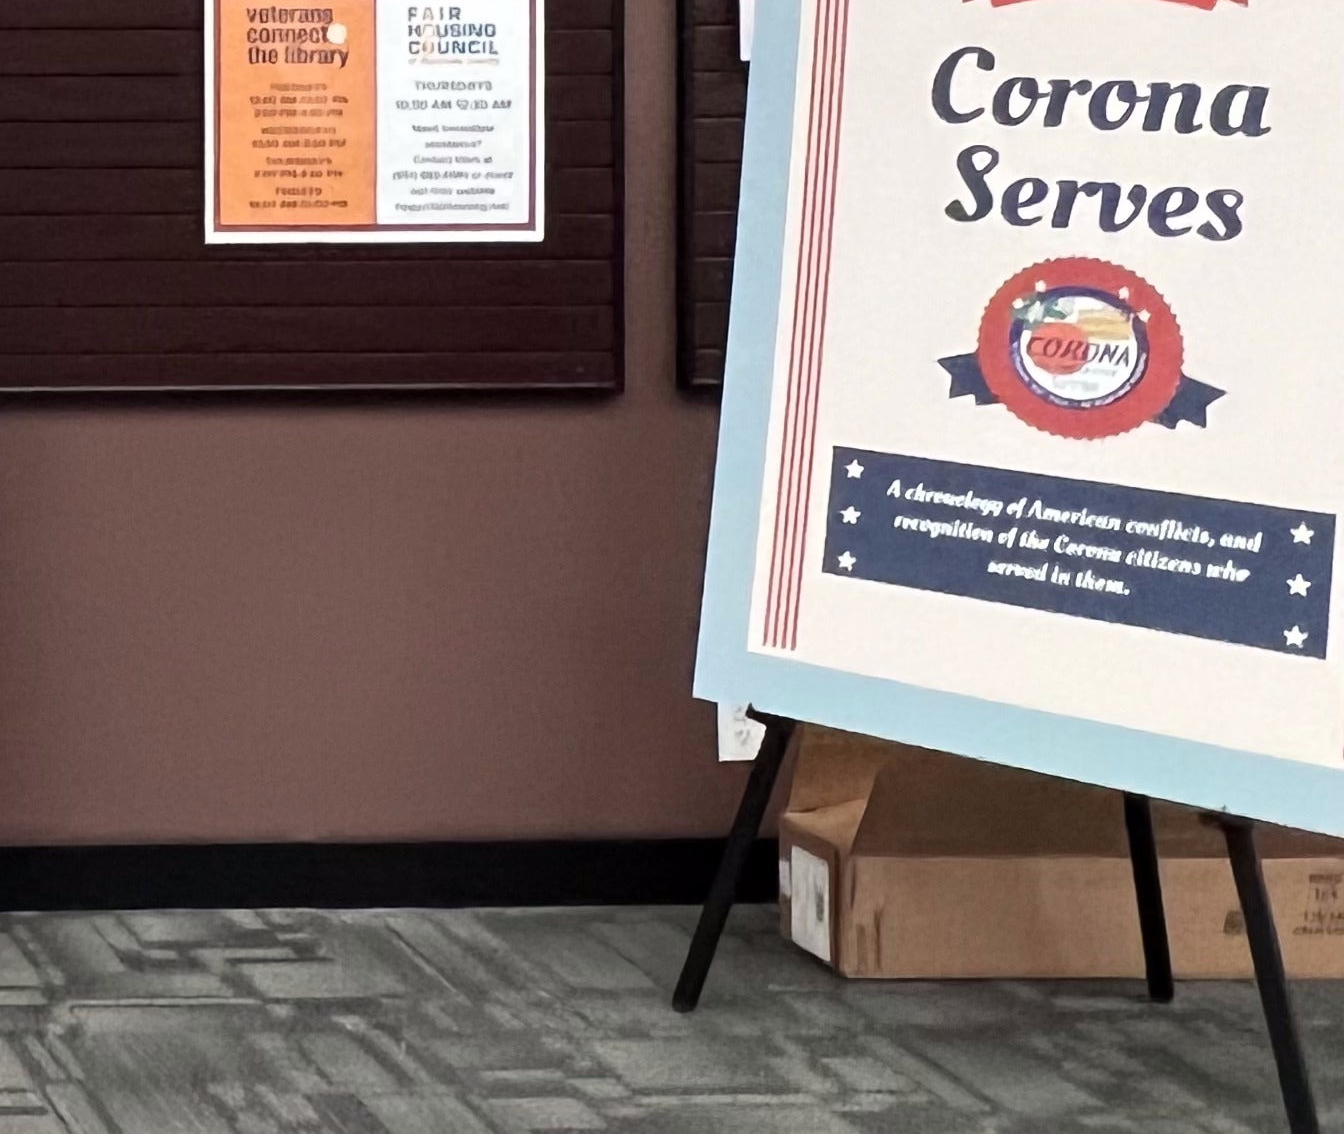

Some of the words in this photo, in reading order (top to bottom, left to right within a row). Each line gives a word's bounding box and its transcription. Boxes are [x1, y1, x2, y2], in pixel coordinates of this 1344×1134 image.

[408, 7, 461, 21] FAIR
[408, 23, 497, 38] HOUSING
[249, 46, 278, 64] the
[284, 46, 349, 69] library
[408, 40, 499, 55] COUNCIL
[931, 46, 1272, 138] Corona
[945, 144, 1245, 243] Serves
[1027, 337, 1129, 367] CORONA
[886, 479, 901, 498] A
[905, 484, 1002, 518] chronology
[1007, 497, 1027, 519] of
[1028, 498, 1121, 532] American
[1126, 517, 1215, 547] conflicts,
[1219, 531, 1263, 553] and
[894, 514, 992, 543] recognition
[998, 526, 1017, 548] of
[1020, 531, 1048, 551] the
[1053, 534, 1123, 563] Corona
[1125, 545, 1201, 576] citizens
[1207, 560, 1251, 583] who
[987, 560, 1047, 582] served
[1051, 564, 1071, 586] in
[1075, 571, 1131, 595] them.
